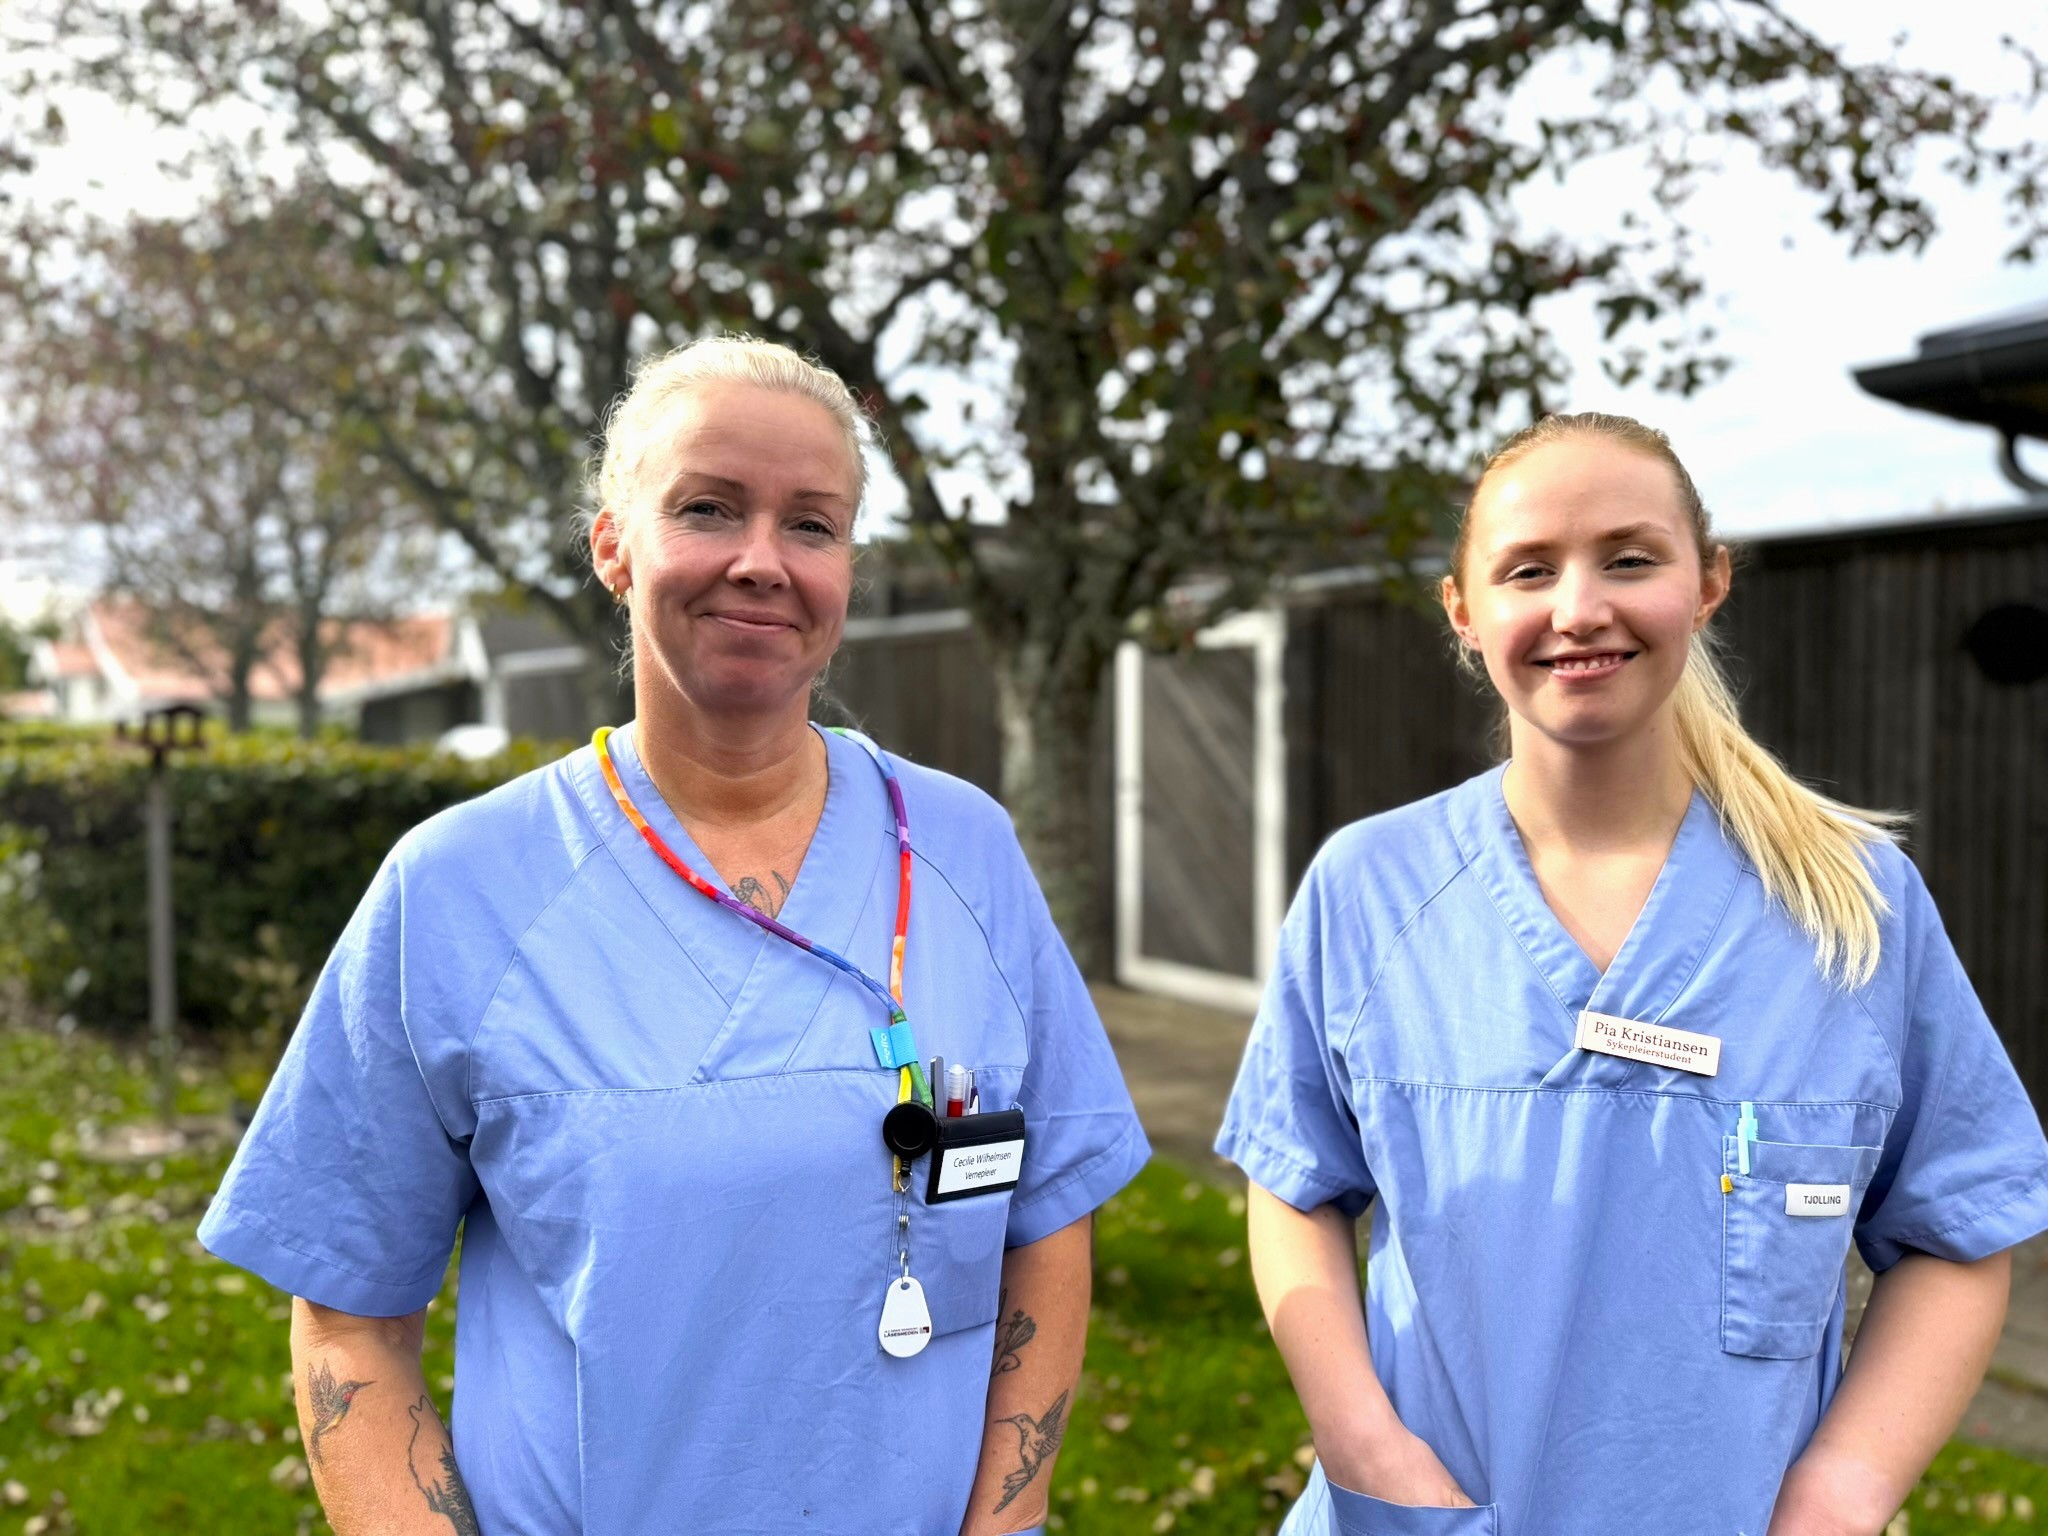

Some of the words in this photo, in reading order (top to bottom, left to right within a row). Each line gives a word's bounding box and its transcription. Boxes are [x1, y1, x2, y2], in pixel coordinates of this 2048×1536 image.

[1594, 1021, 1617, 1037] Pia
[1621, 1027, 1709, 1056] Kristiansen
[1606, 1039, 1692, 1064] Sykepleierstudent
[954, 1156, 975, 1168] Cecilie
[976, 1152, 1012, 1165] Wilhelmsen
[1803, 1195, 1841, 1205] TJØLLING
